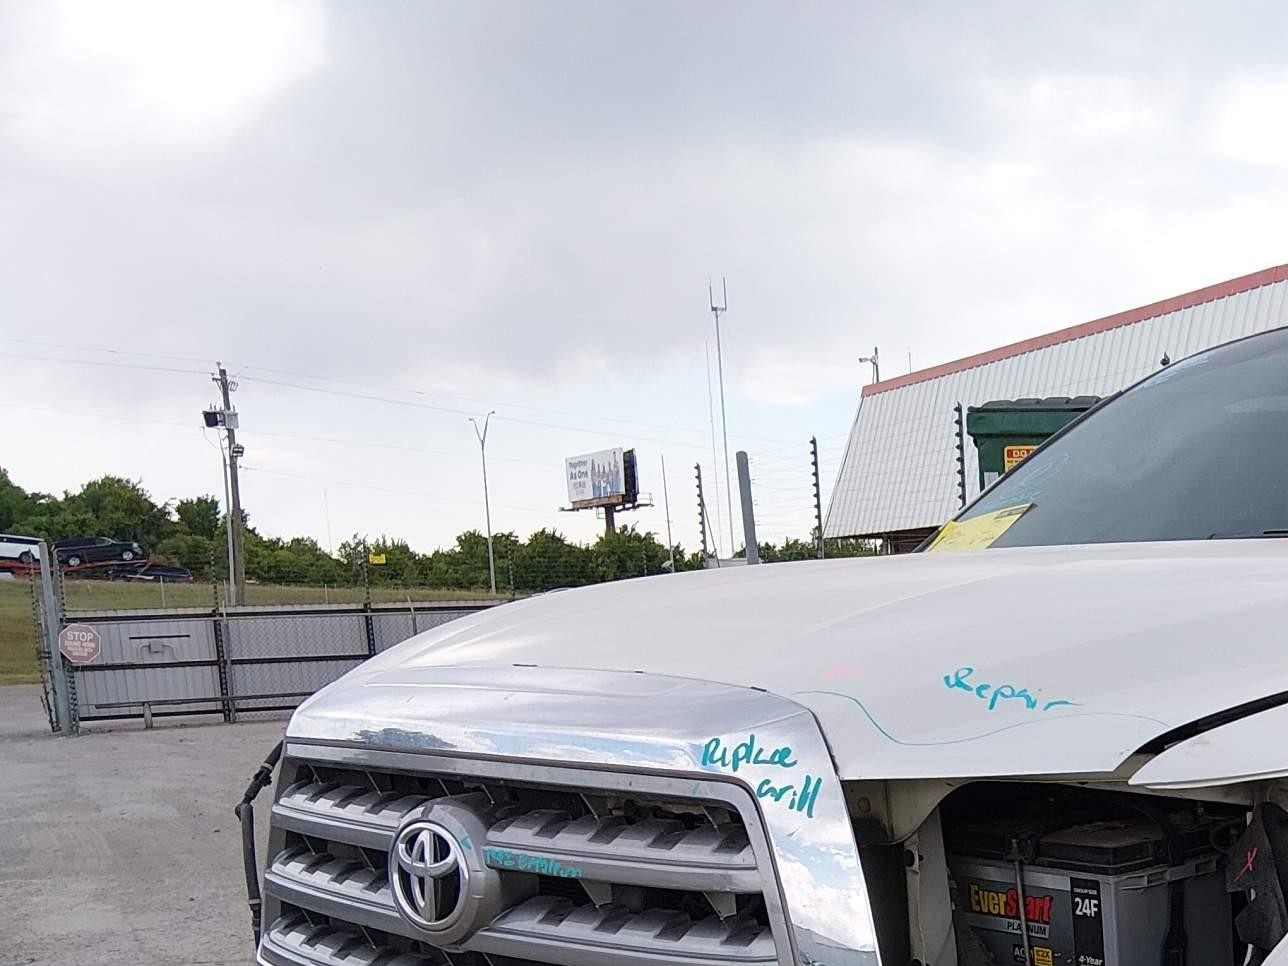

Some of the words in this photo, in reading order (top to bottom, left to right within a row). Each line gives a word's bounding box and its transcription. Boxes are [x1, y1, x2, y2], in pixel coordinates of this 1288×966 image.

[66, 631, 94, 641] STOP
[970, 884, 1053, 923] EverSart
[1074, 897, 1099, 917] 24F
[1007, 921, 1047, 937] PLANUM
[1078, 954, 1103, 966] 4-Year
